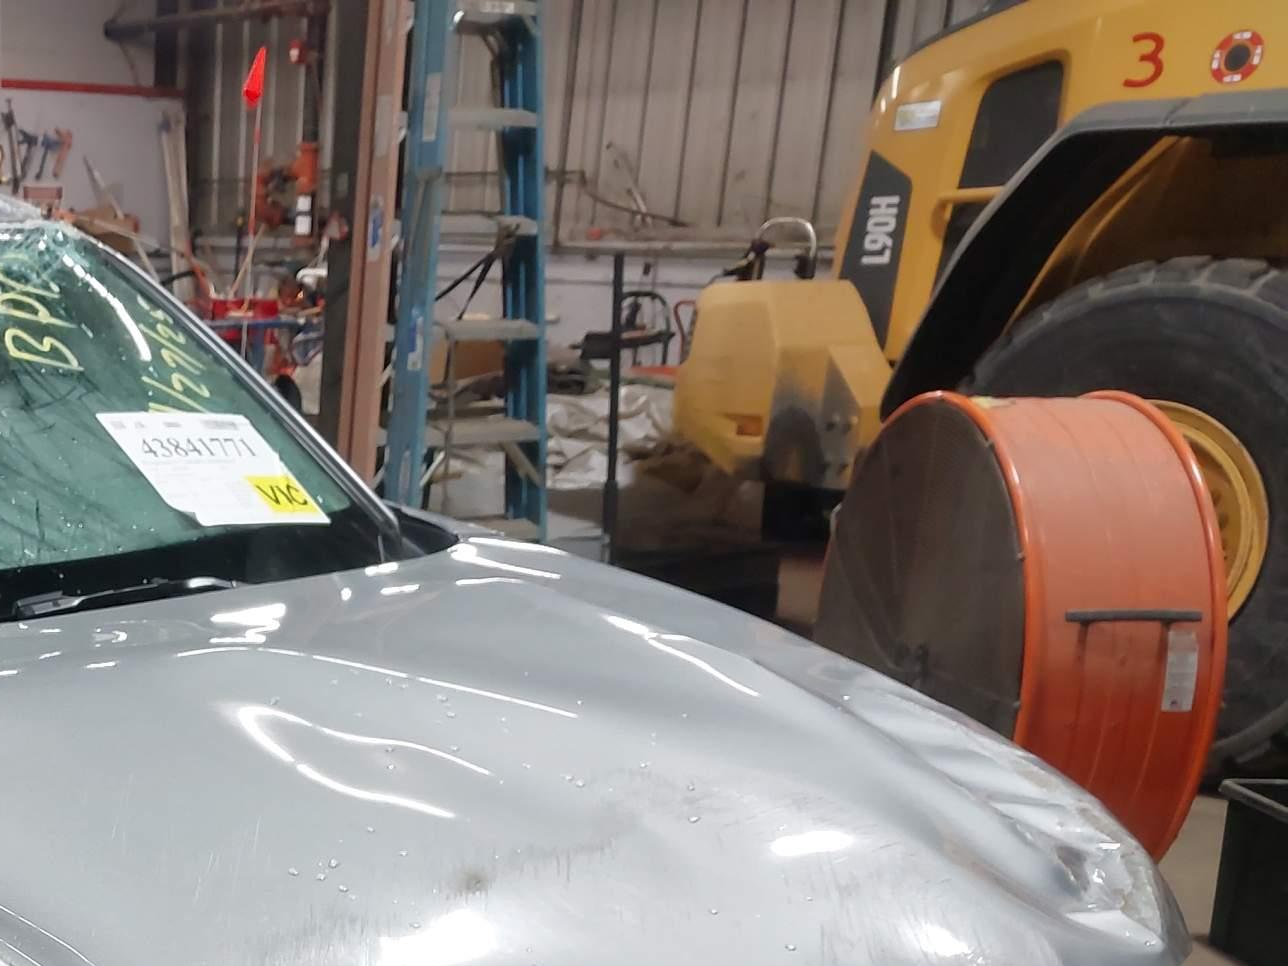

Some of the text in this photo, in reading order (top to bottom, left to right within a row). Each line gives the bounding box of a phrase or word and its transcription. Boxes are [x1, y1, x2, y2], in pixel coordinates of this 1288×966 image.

[1122, 31, 1165, 88] 3
[860, 195, 901, 265] L90H
[141, 438, 257, 458] 43841771
